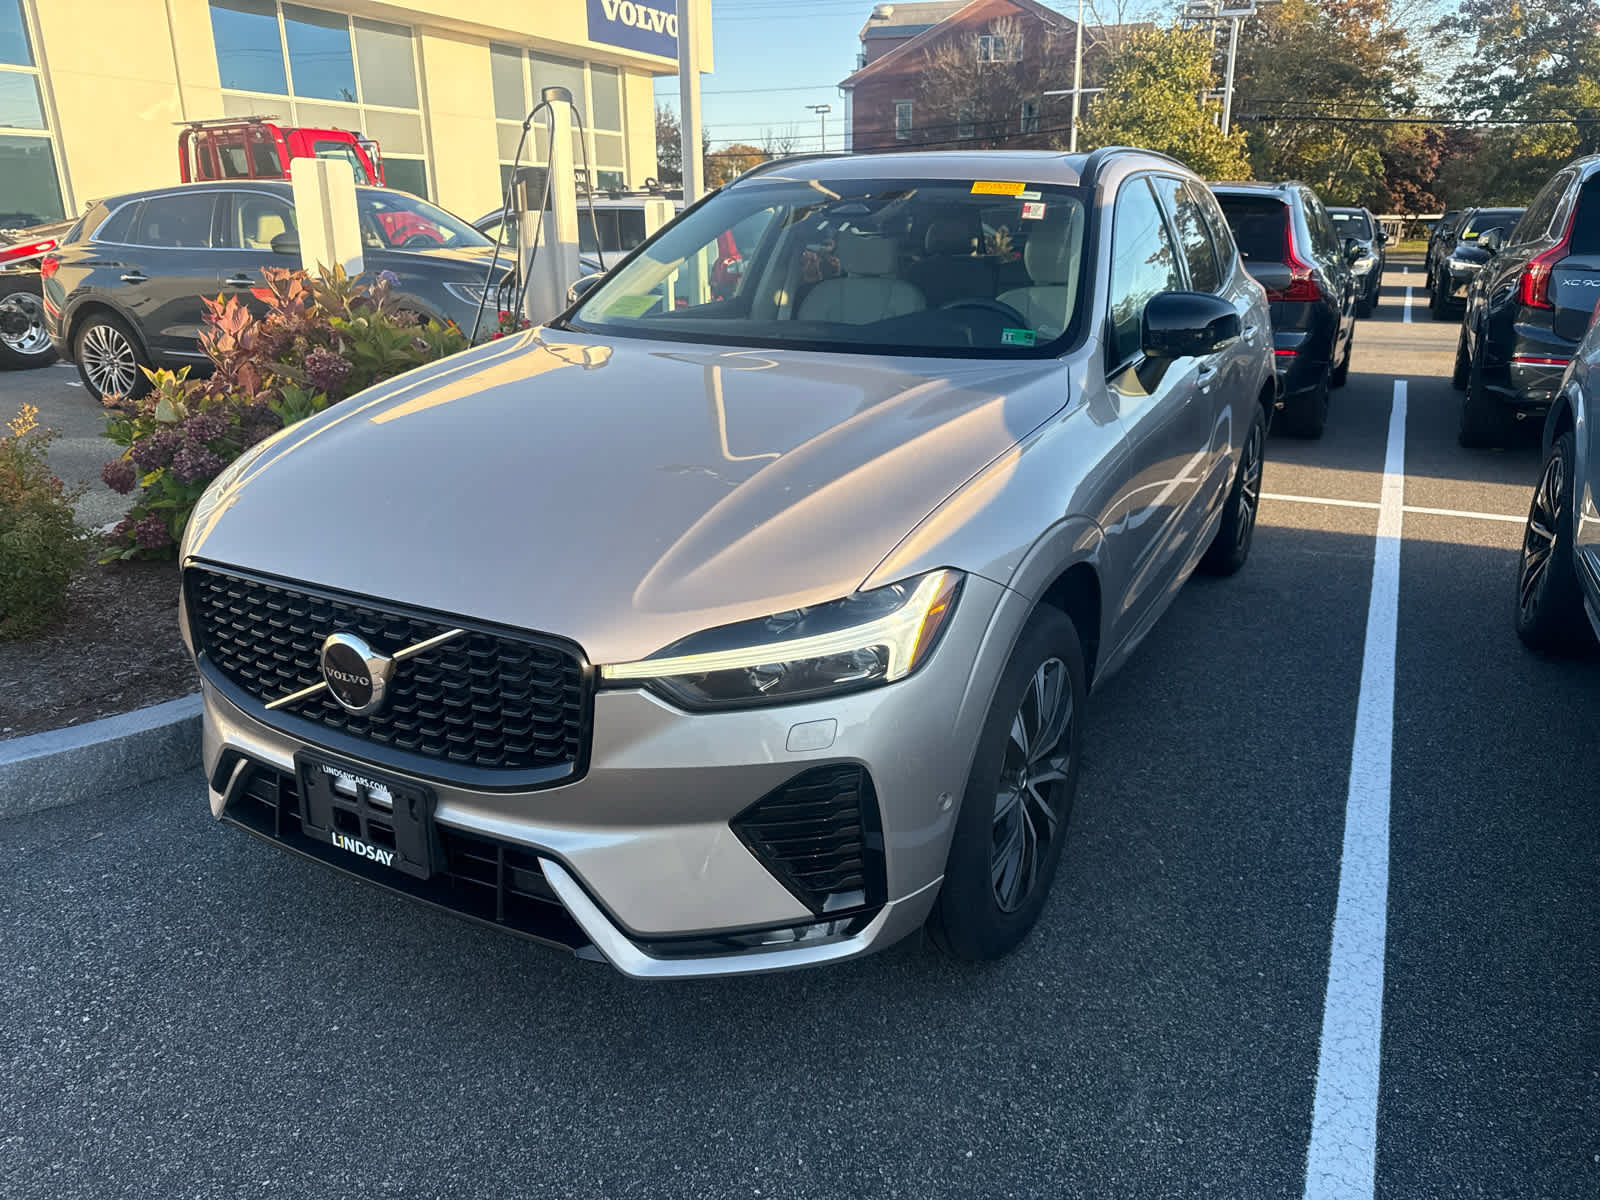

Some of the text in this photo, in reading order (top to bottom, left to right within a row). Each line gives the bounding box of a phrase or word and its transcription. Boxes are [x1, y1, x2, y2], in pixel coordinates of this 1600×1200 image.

[602, 0, 678, 38] VOLVO
[325, 667, 370, 686] VOLVO
[322, 764, 388, 793] LINDSAYCARS.COM
